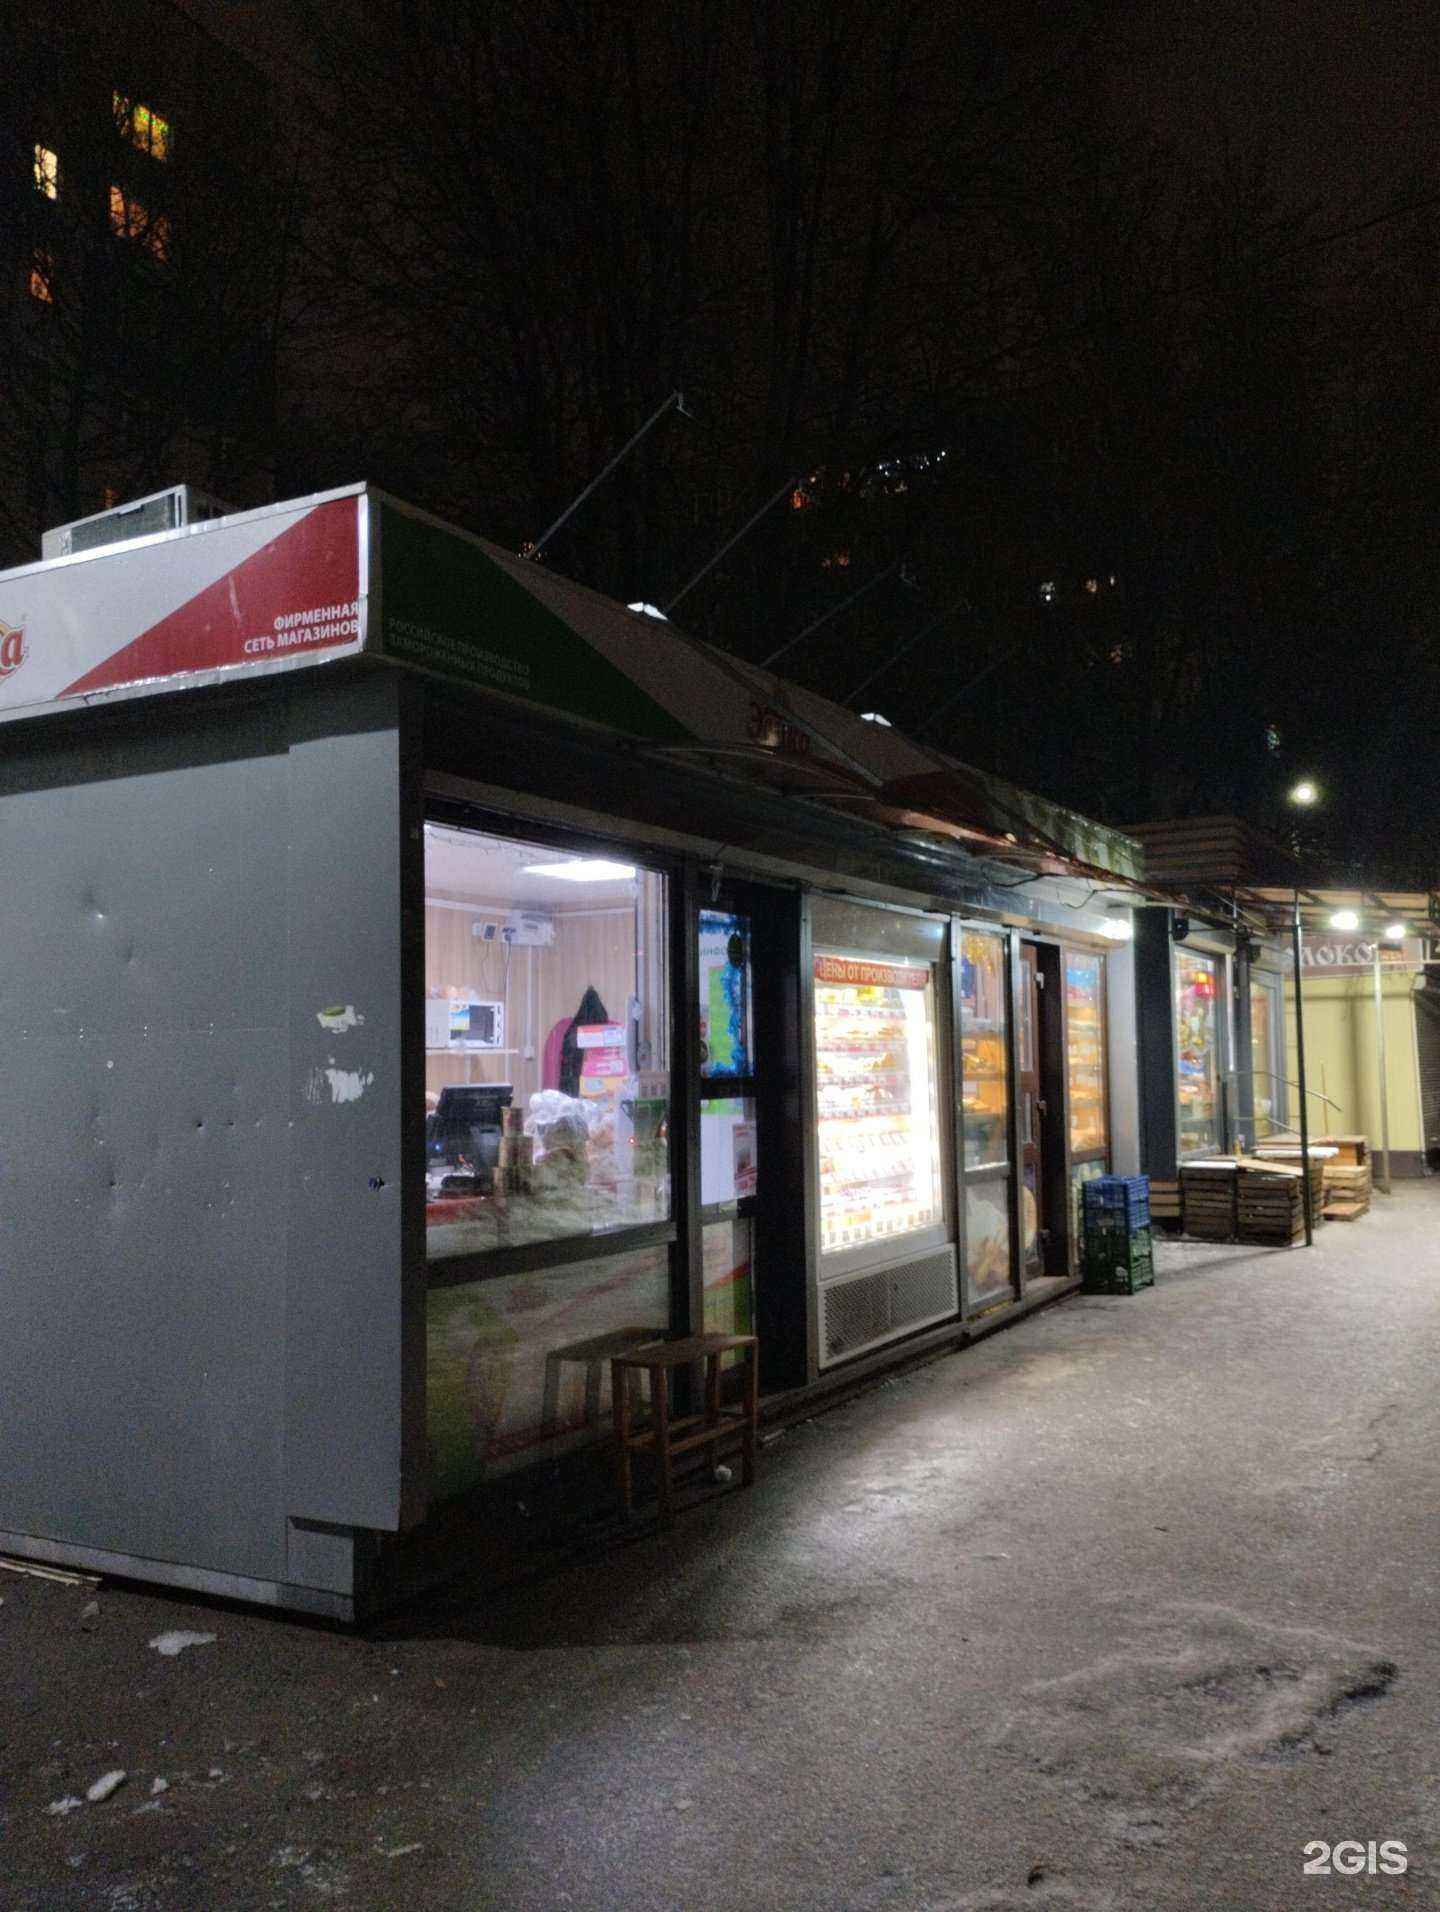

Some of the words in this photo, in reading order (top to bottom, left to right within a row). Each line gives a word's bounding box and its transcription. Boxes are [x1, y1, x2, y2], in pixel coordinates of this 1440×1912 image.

[274, 601, 360, 630] ФИРМЕННАЯ
[244, 635, 275, 653] СЕТЬ
[277, 619, 360, 648] МАГАЗИНОВ
[848, 963, 859, 980] ОТ
